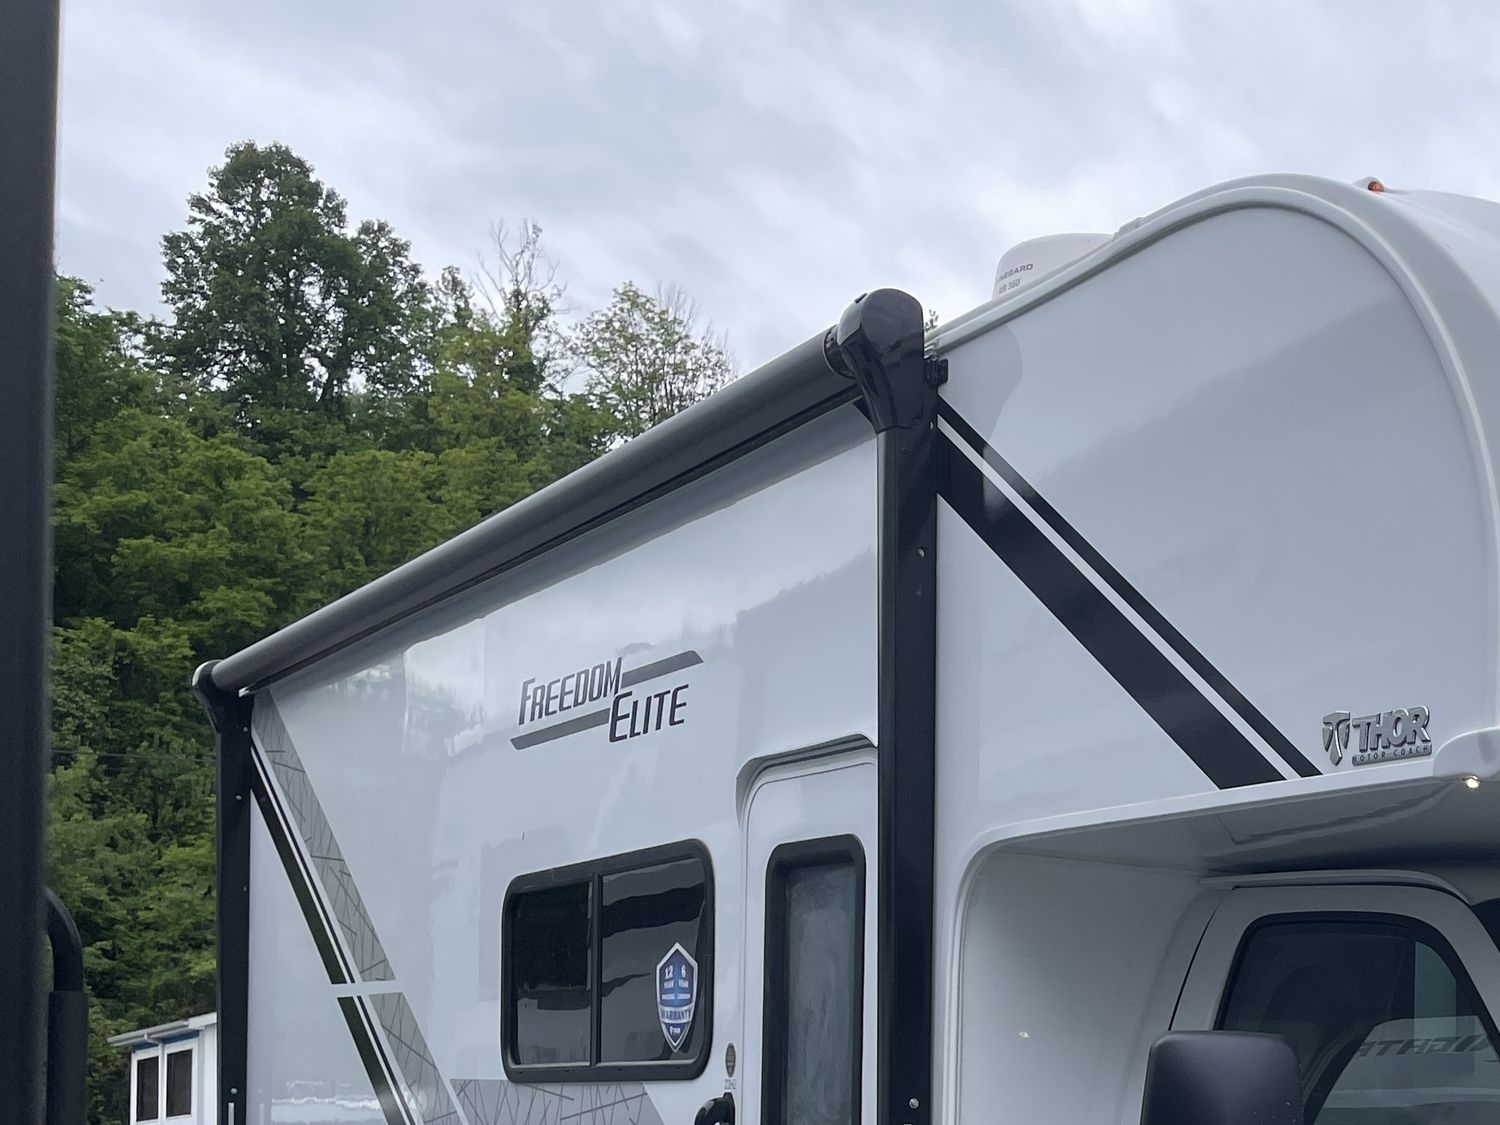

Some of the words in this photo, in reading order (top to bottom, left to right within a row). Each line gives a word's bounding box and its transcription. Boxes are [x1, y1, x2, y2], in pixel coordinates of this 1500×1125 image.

[518, 656, 623, 726] FREEDOM
[609, 684, 689, 743] ELITE
[1352, 705, 1431, 753] THOR
[1352, 750, 1386, 762] MOTOR
[1393, 744, 1428, 757] COACH
[665, 964, 674, 980] 12
[681, 964, 687, 979] 6
[661, 1008, 692, 1020] WARRANTY
